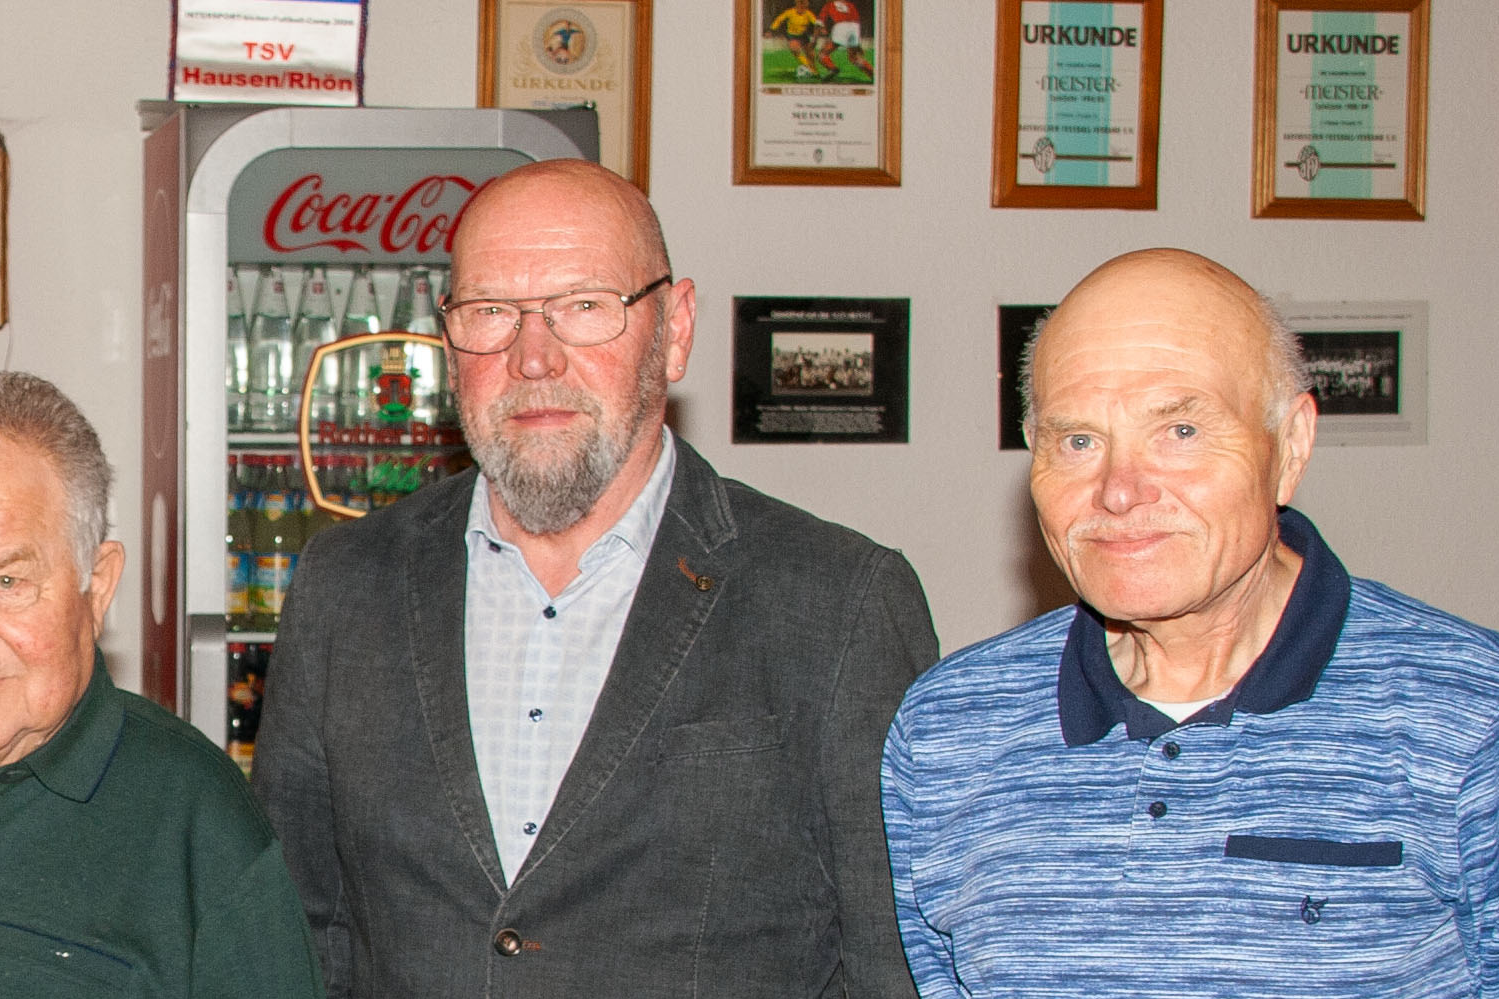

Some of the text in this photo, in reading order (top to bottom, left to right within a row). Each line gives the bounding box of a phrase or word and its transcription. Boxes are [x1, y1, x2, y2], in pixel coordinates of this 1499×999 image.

[1023, 24, 1138, 48] URKUNDE
[1287, 33, 1400, 55] URKUNDE
[243, 42, 295, 61] TSV
[183, 66, 353, 91] Hausen/Rhön
[512, 78, 616, 91] URKUNDE
[263, 173, 499, 254] Coca-Col
[318, 421, 404, 446] Rother
